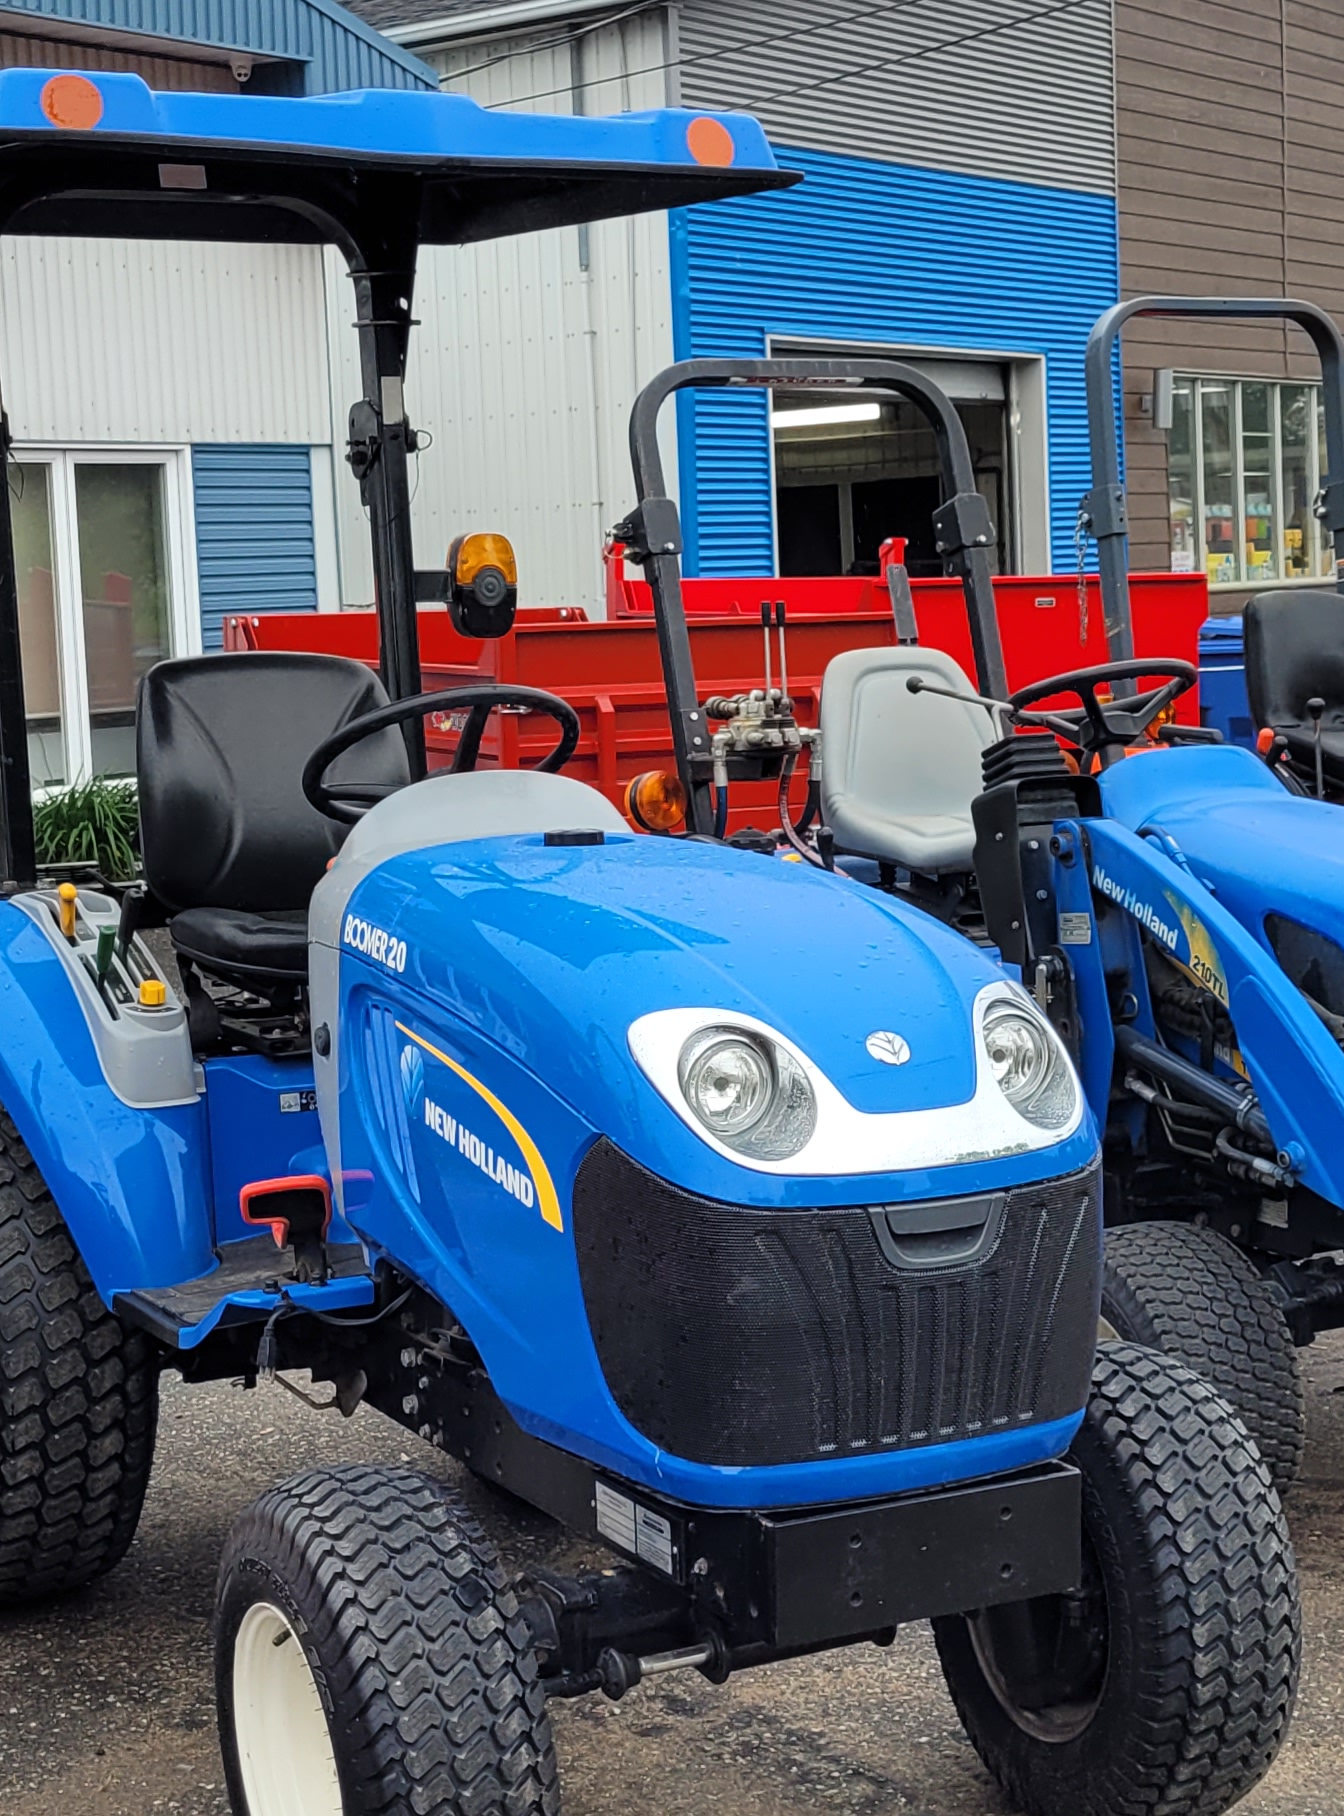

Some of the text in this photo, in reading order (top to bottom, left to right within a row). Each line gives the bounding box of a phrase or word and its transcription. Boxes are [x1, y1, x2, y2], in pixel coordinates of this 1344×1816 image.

[343, 913, 407, 973] BOOMER 20
[1092, 865, 1125, 903] New
[1123, 887, 1179, 950] Holland
[1192, 955, 1226, 1000] 210TL
[424, 1096, 534, 1208] NEW HOLLAND
